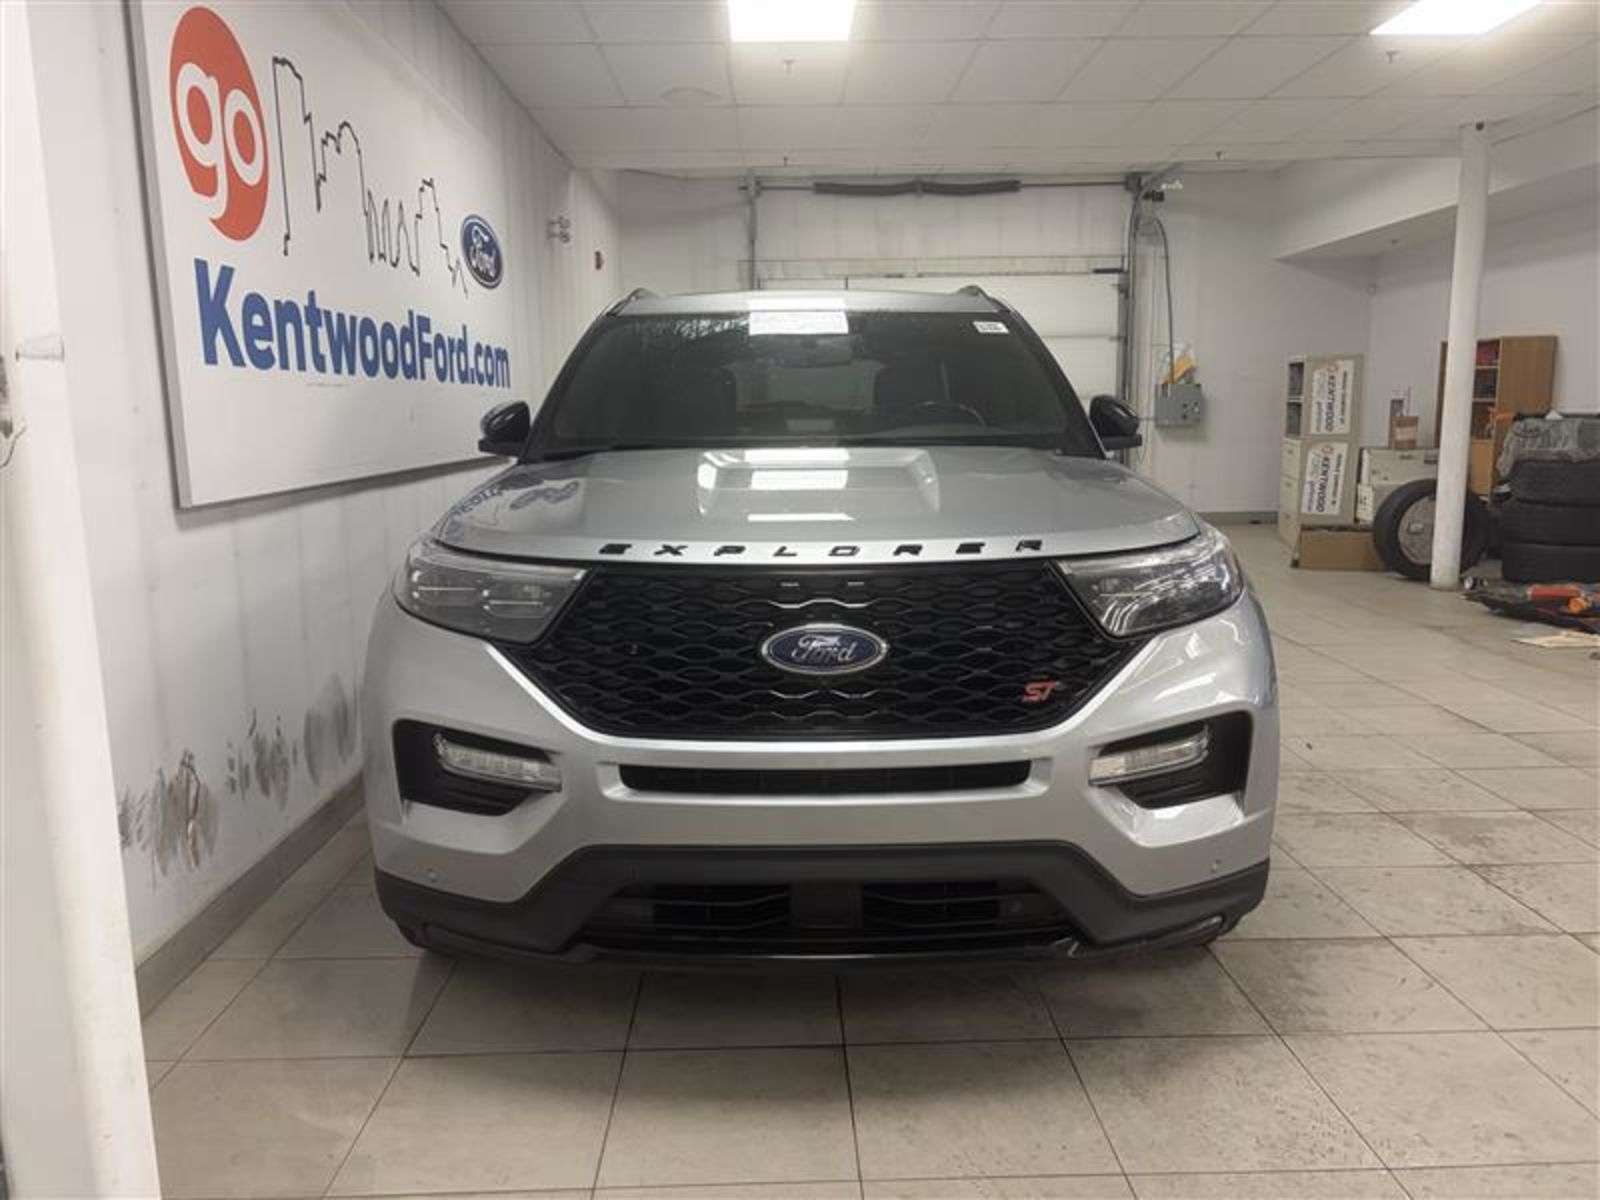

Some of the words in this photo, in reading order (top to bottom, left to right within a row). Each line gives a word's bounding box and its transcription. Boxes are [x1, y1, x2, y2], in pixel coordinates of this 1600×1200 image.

[176, 62, 264, 222] go
[470, 225, 498, 278] Ford
[194, 258, 511, 389] KentwoodFord.com
[599, 540, 1044, 557] EXPLORER
[790, 633, 857, 665] Ford
[1022, 680, 1060, 702] ST
